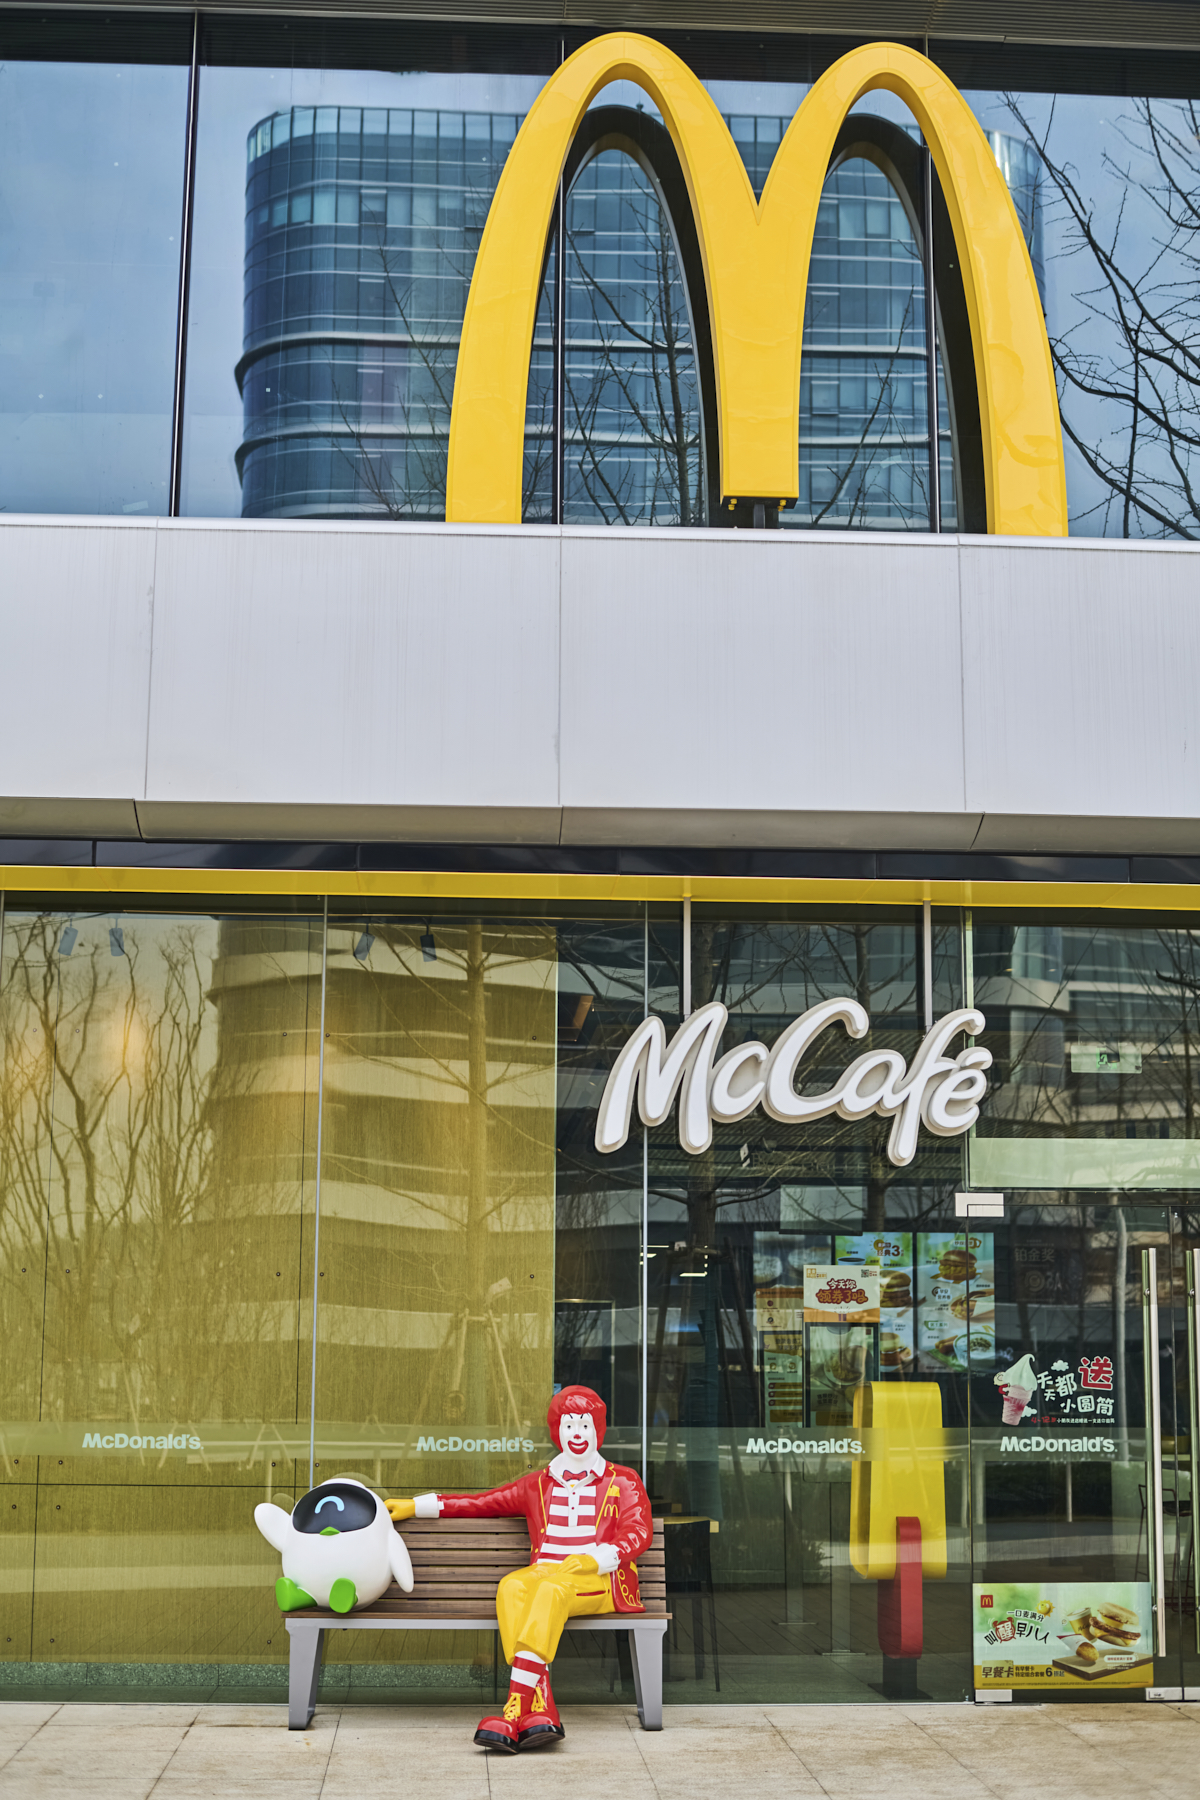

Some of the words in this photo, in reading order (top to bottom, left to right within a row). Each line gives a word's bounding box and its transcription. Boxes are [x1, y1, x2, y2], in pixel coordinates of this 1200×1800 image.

[595, 997, 992, 1166] McCafé
[827, 1279, 857, 1290] 今天你
[816, 1289, 868, 1304] 领券了吗
[982, 1666, 1014, 1678] 早餐卡
